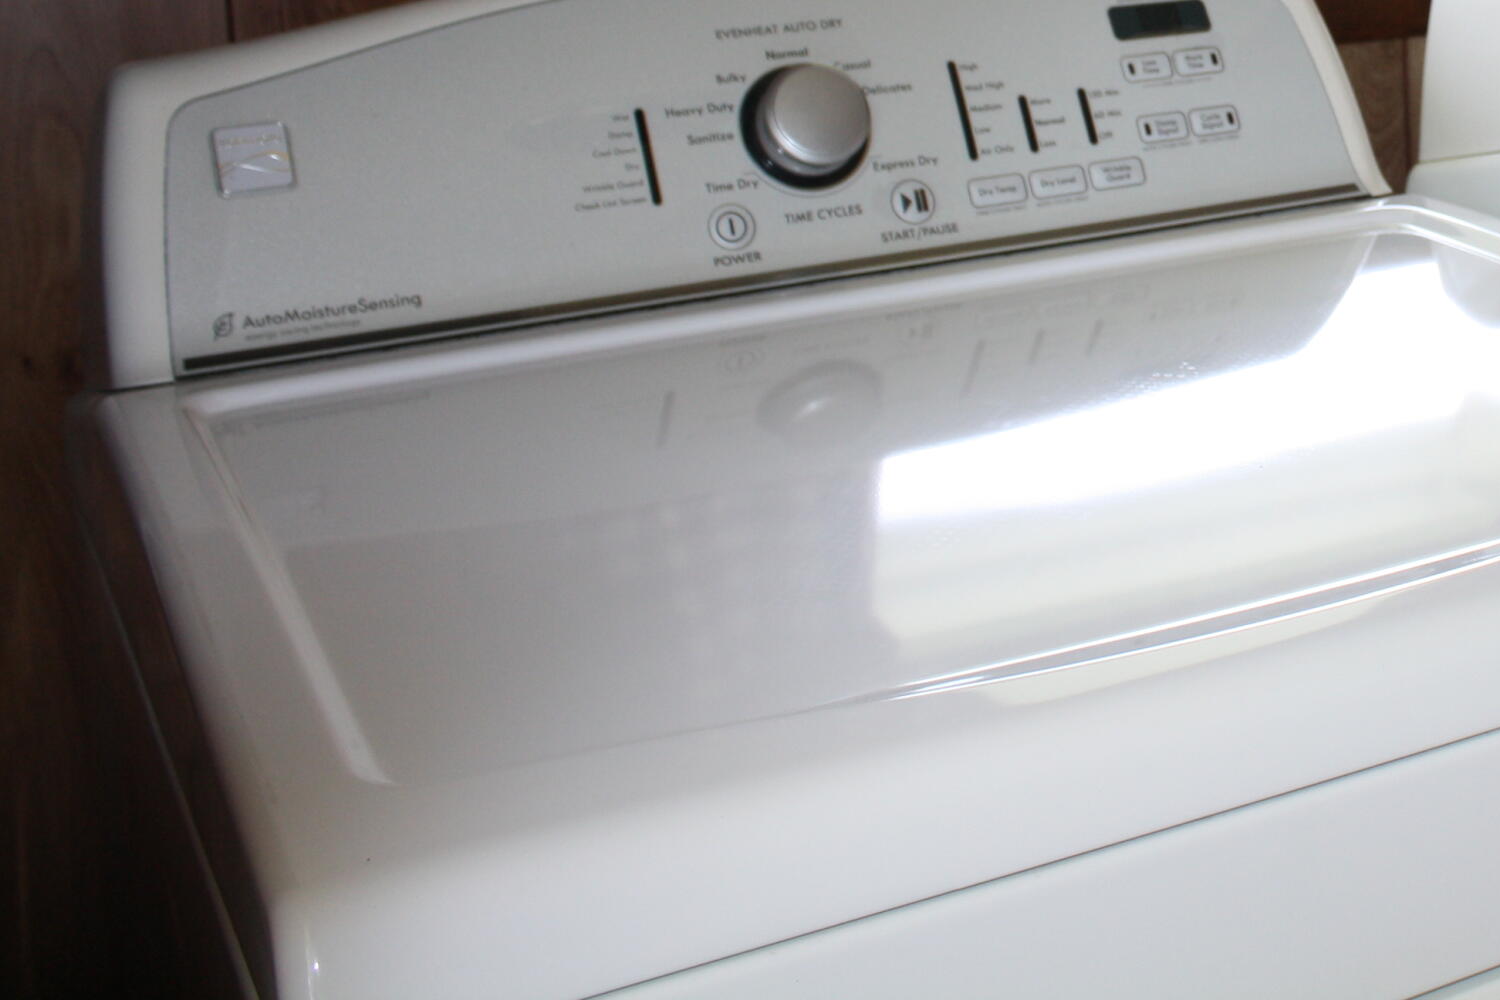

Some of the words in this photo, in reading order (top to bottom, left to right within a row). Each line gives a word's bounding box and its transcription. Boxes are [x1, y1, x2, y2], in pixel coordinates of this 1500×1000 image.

[715, 25, 778, 40] EVENHEAT
[783, 21, 816, 34] AUTO
[820, 18, 843, 30] DRY
[765, 47, 809, 61] Normal
[716, 73, 747, 86] Bulky
[665, 104, 703, 119] Heavy
[707, 102, 734, 115] Duty
[686, 132, 735, 146] Sanitize
[872, 159, 915, 173] Express
[917, 155, 938, 168] Dry
[705, 181, 734, 194] Time
[738, 178, 759, 191] Dry
[784, 212, 813, 225] TIME
[817, 204, 862, 220] CYCLES
[881, 222, 959, 243] START/PAUSE
[713, 251, 762, 268] POWER
[242, 293, 423, 330] AutoMoistureSensing
